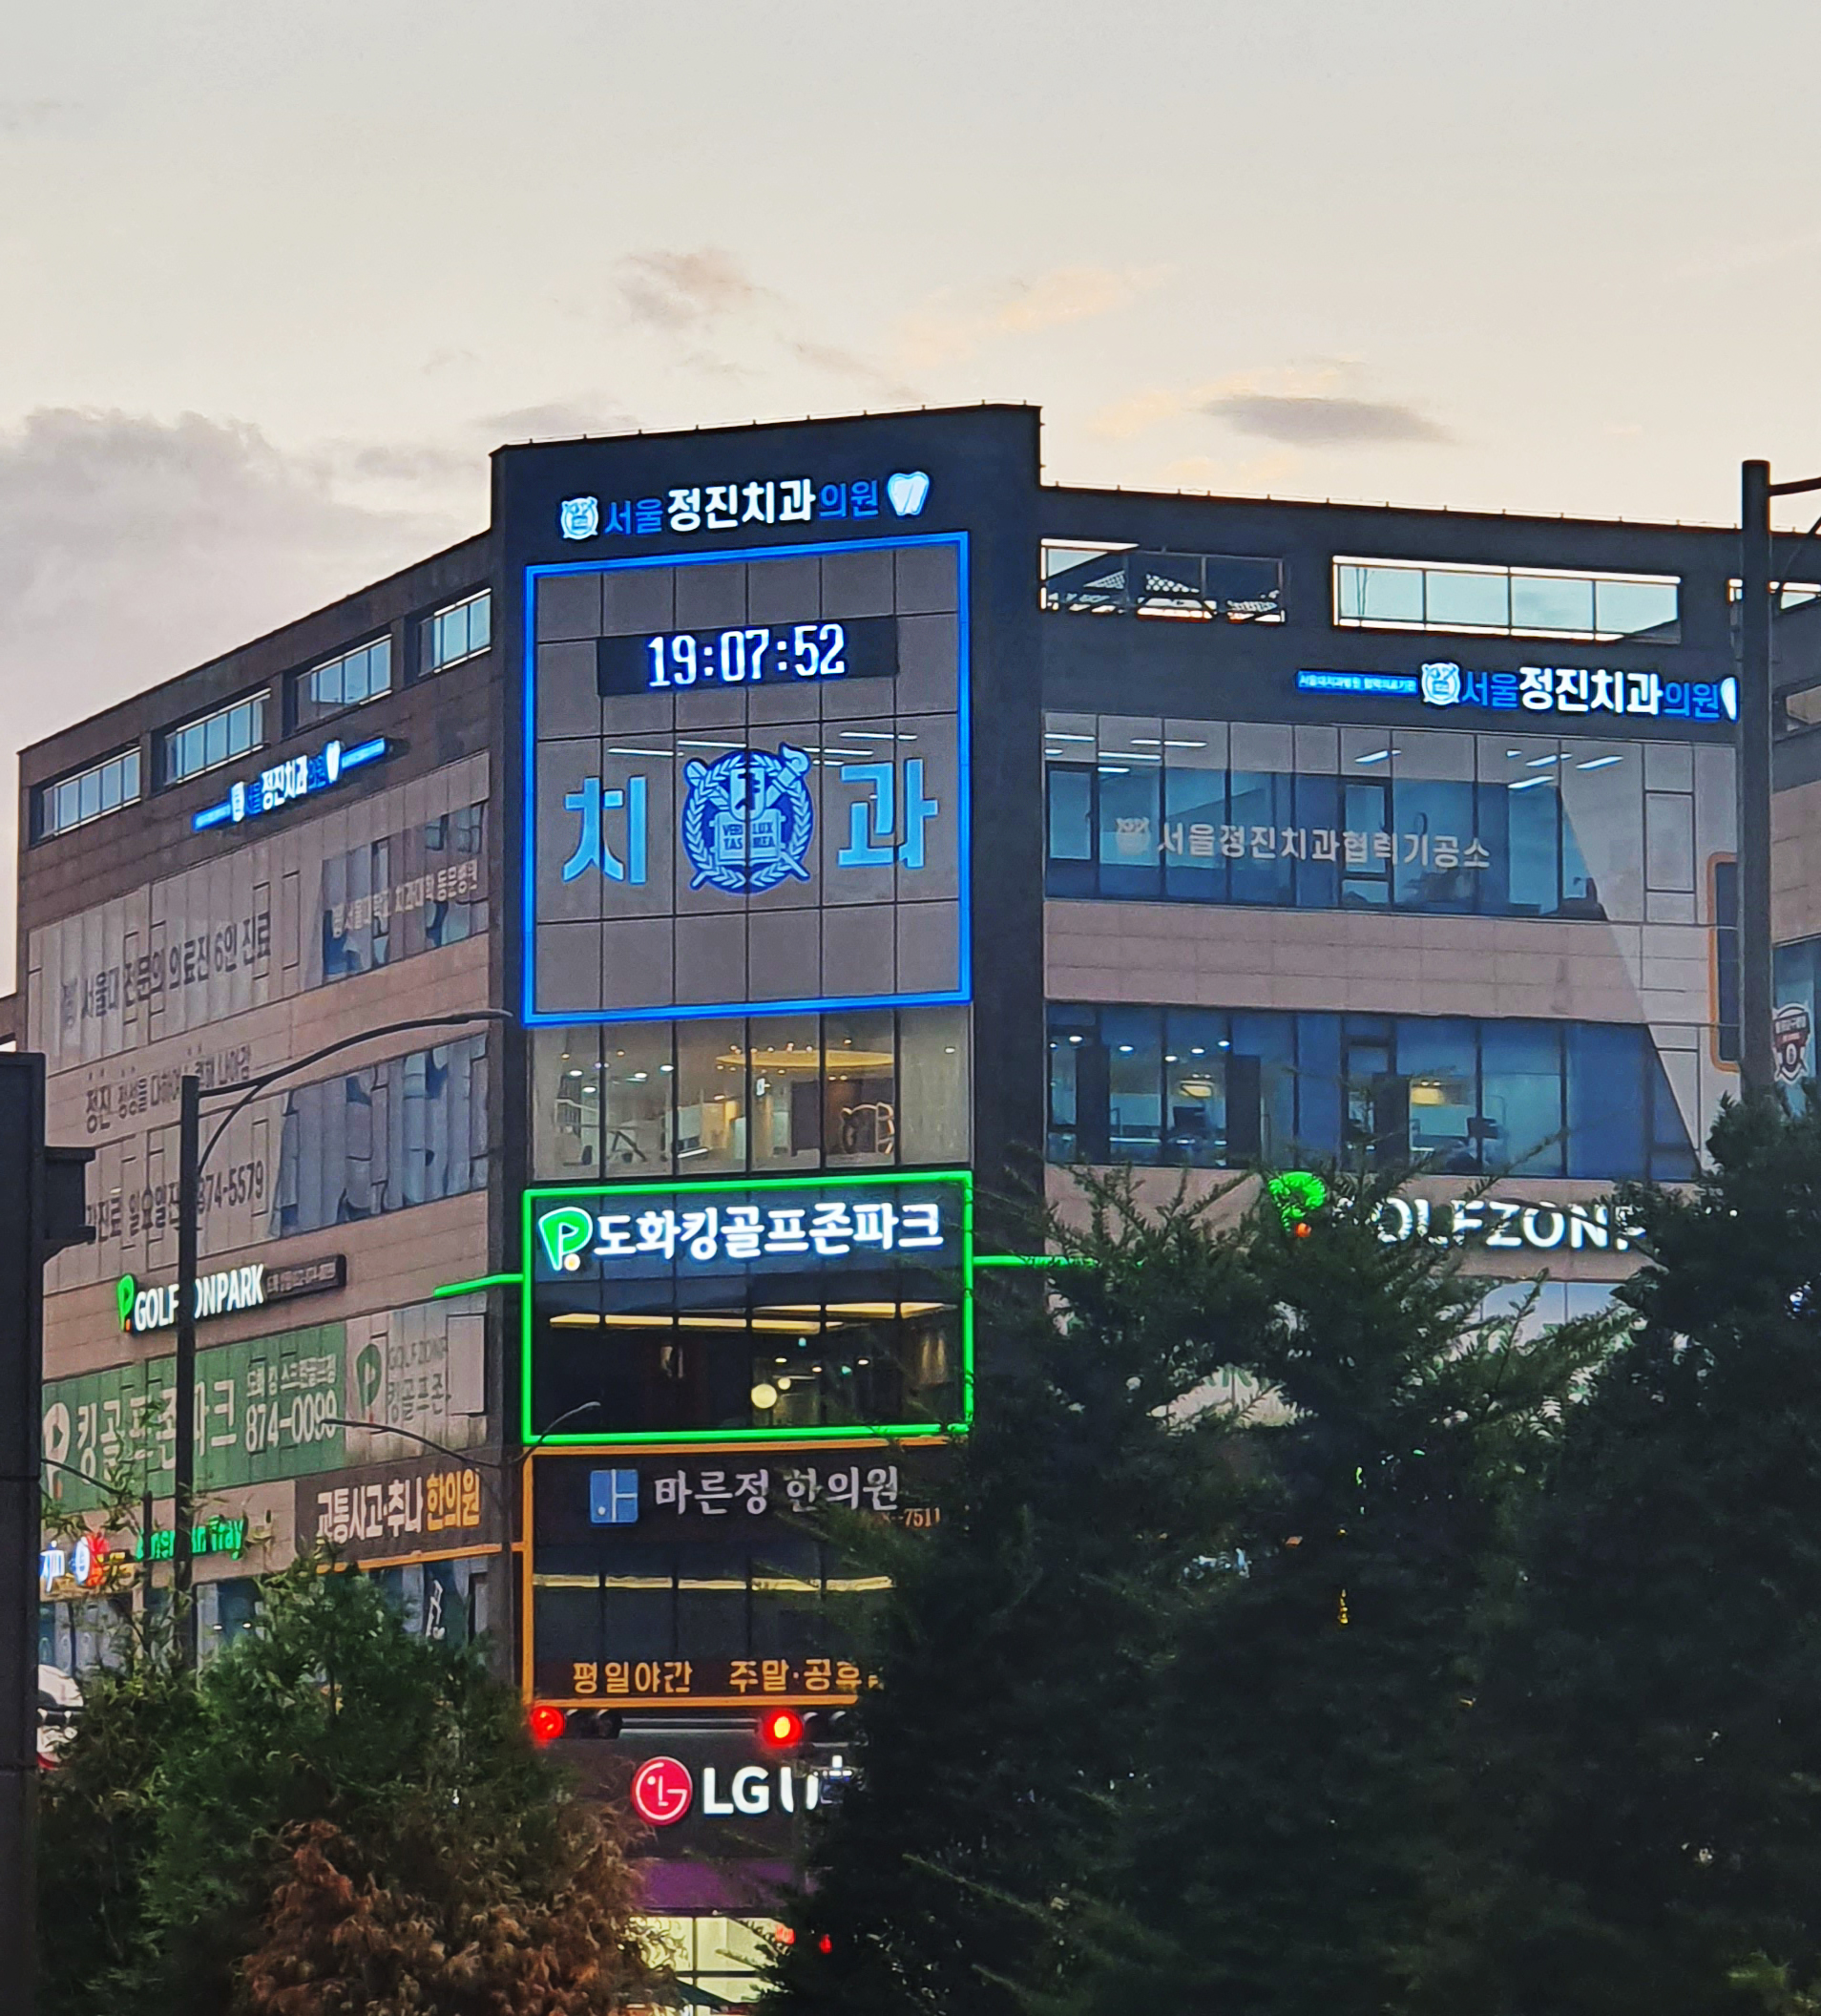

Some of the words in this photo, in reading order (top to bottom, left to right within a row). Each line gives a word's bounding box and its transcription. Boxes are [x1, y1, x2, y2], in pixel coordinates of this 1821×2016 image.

[648, 623, 846, 687] 19:07:52
[563, 776, 647, 885] 치
[838, 759, 938, 869] 과
[169, 934, 209, 989] 의료진
[242, 911, 271, 965] 진료
[593, 1202, 944, 1260] 도화킹골프존파크
[246, 1388, 338, 1452] 874-0099
[427, 1468, 480, 1531] 한의원
[655, 1468, 769, 1515] 바른정
[785, 1466, 899, 1513] 한의원
[573, 1659, 693, 1693] 평일야간
